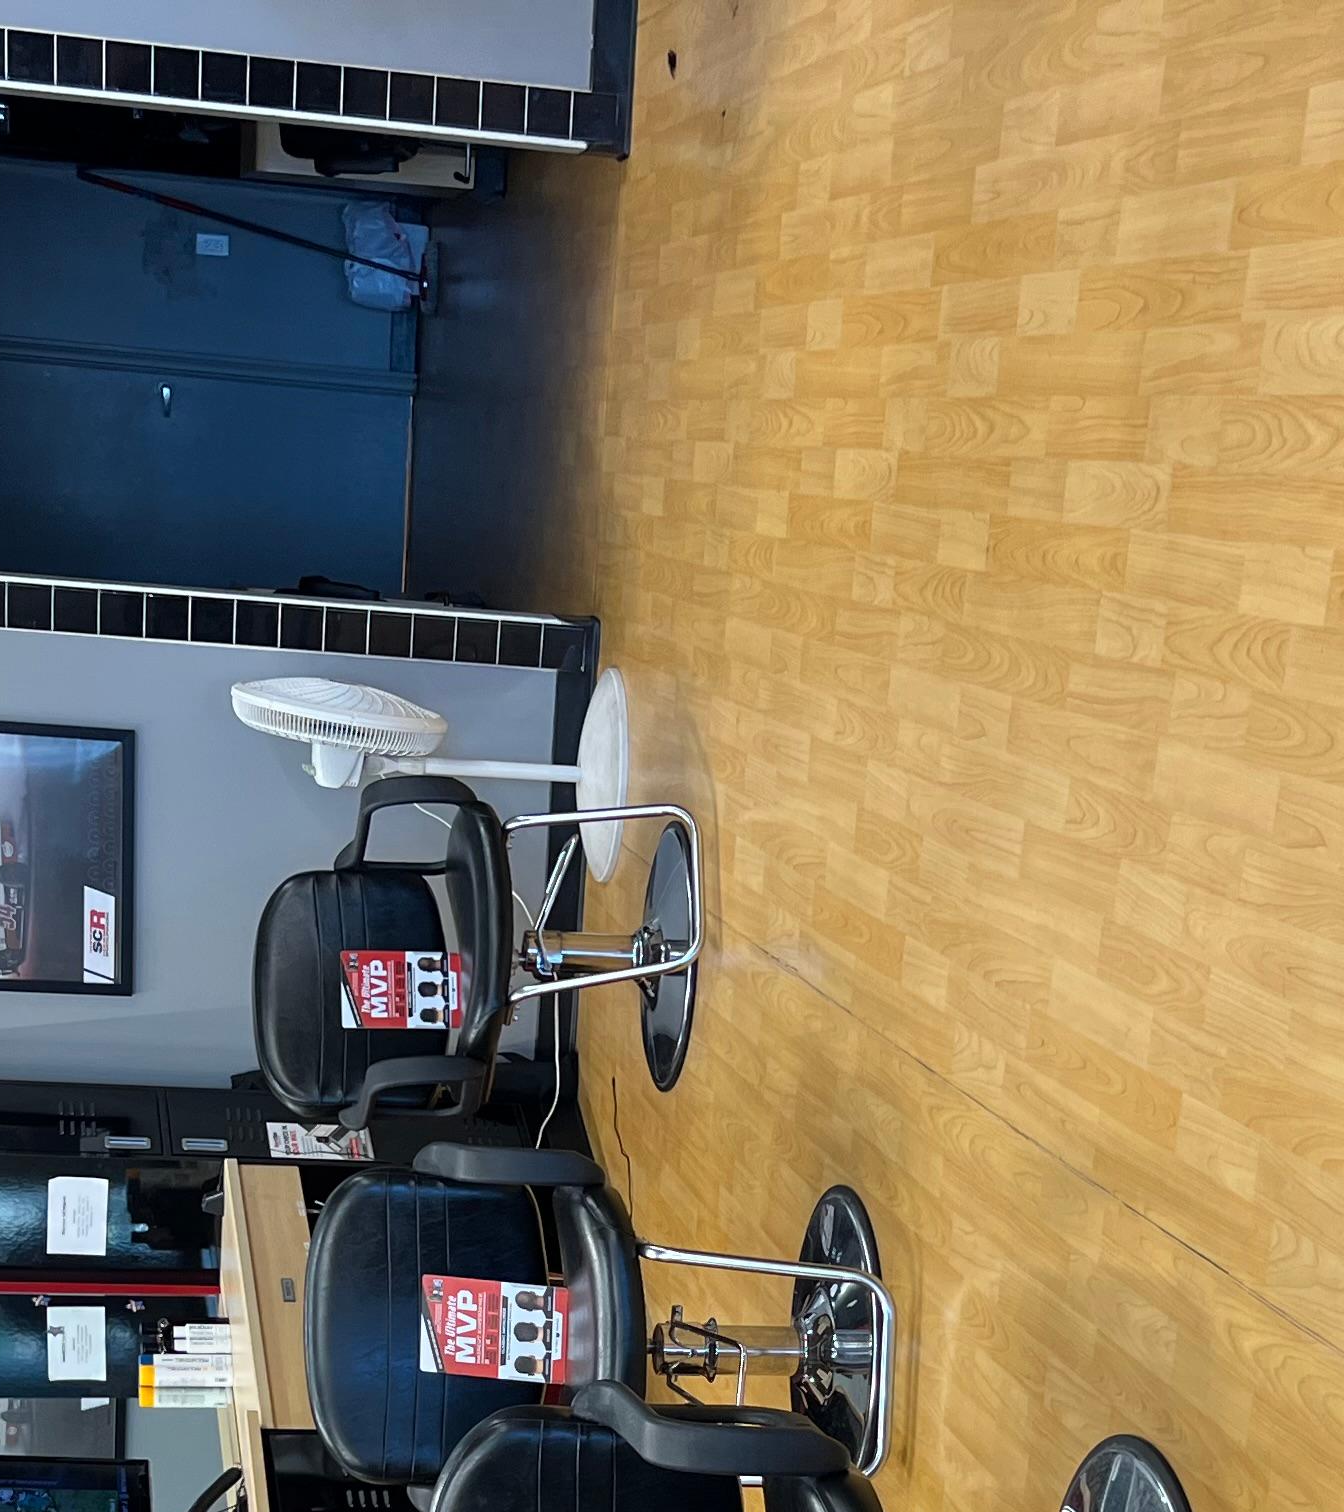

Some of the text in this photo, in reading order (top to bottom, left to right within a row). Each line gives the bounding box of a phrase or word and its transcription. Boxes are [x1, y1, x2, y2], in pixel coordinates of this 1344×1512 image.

[370, 960, 388, 1018] MVP
[444, 1295, 457, 1355] The Ultimate
[455, 1289, 478, 1364] MVP
